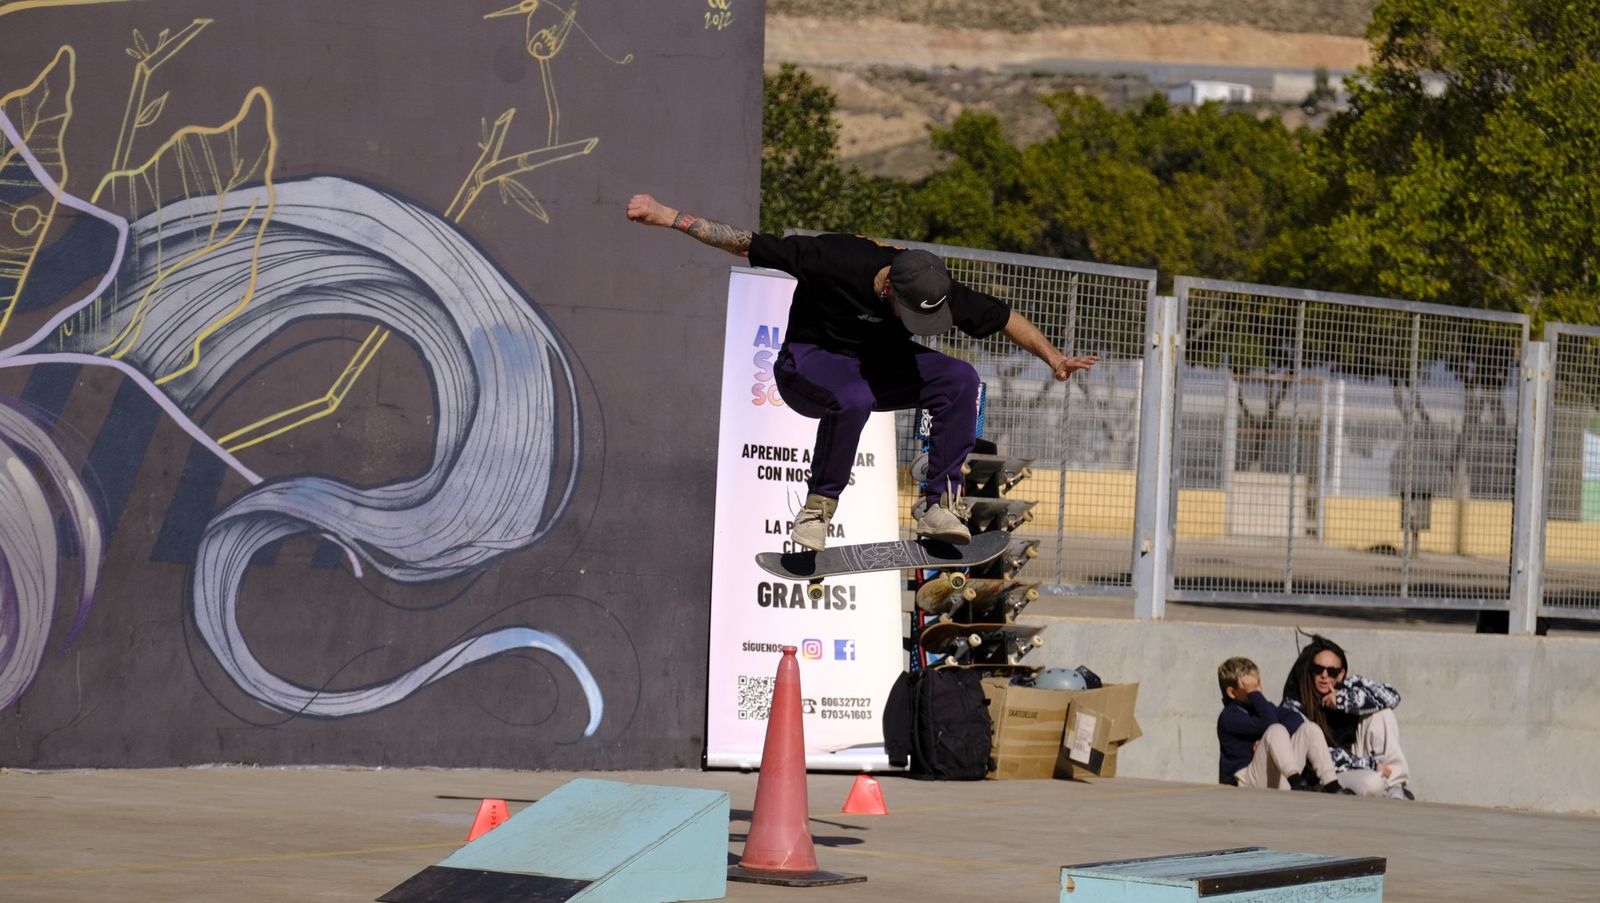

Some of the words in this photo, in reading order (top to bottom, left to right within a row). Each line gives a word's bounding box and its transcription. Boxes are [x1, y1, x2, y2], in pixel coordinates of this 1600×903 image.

[742, 443, 798, 462] APRENDE
[802, 449, 811, 463] A
[757, 465, 782, 481] CON
[765, 519, 782, 534] LA
[821, 697, 871, 707] 606327127
[821, 709, 872, 720] 670341603
